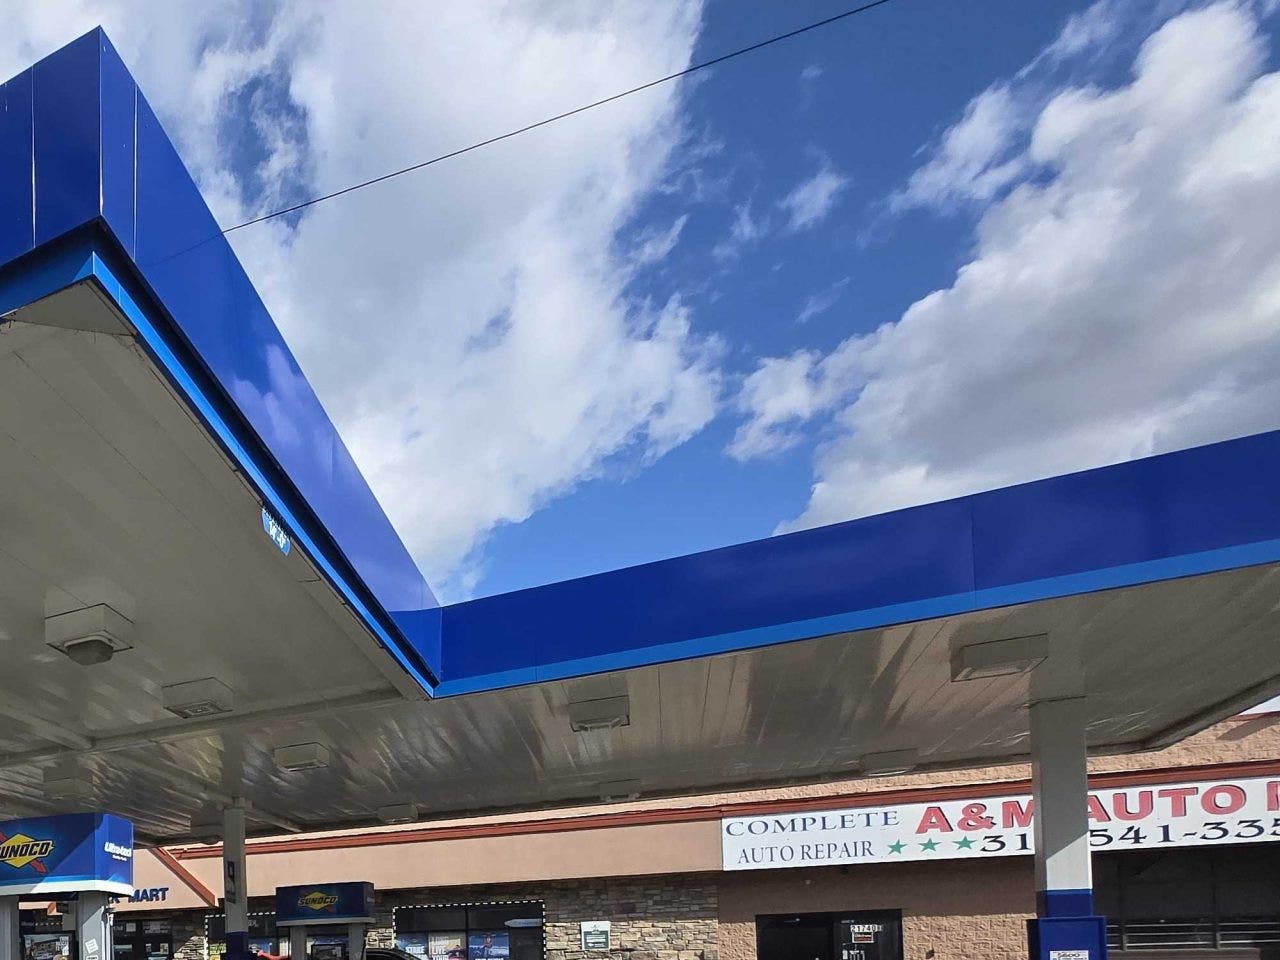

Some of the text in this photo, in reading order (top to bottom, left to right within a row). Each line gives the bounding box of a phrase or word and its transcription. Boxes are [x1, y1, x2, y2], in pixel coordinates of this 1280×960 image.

[726, 811, 900, 837] COMPLETE
[738, 840, 874, 864] AUTO REPAIR
[128, 887, 169, 903] MART
[298, 896, 337, 906] SUNOCO
